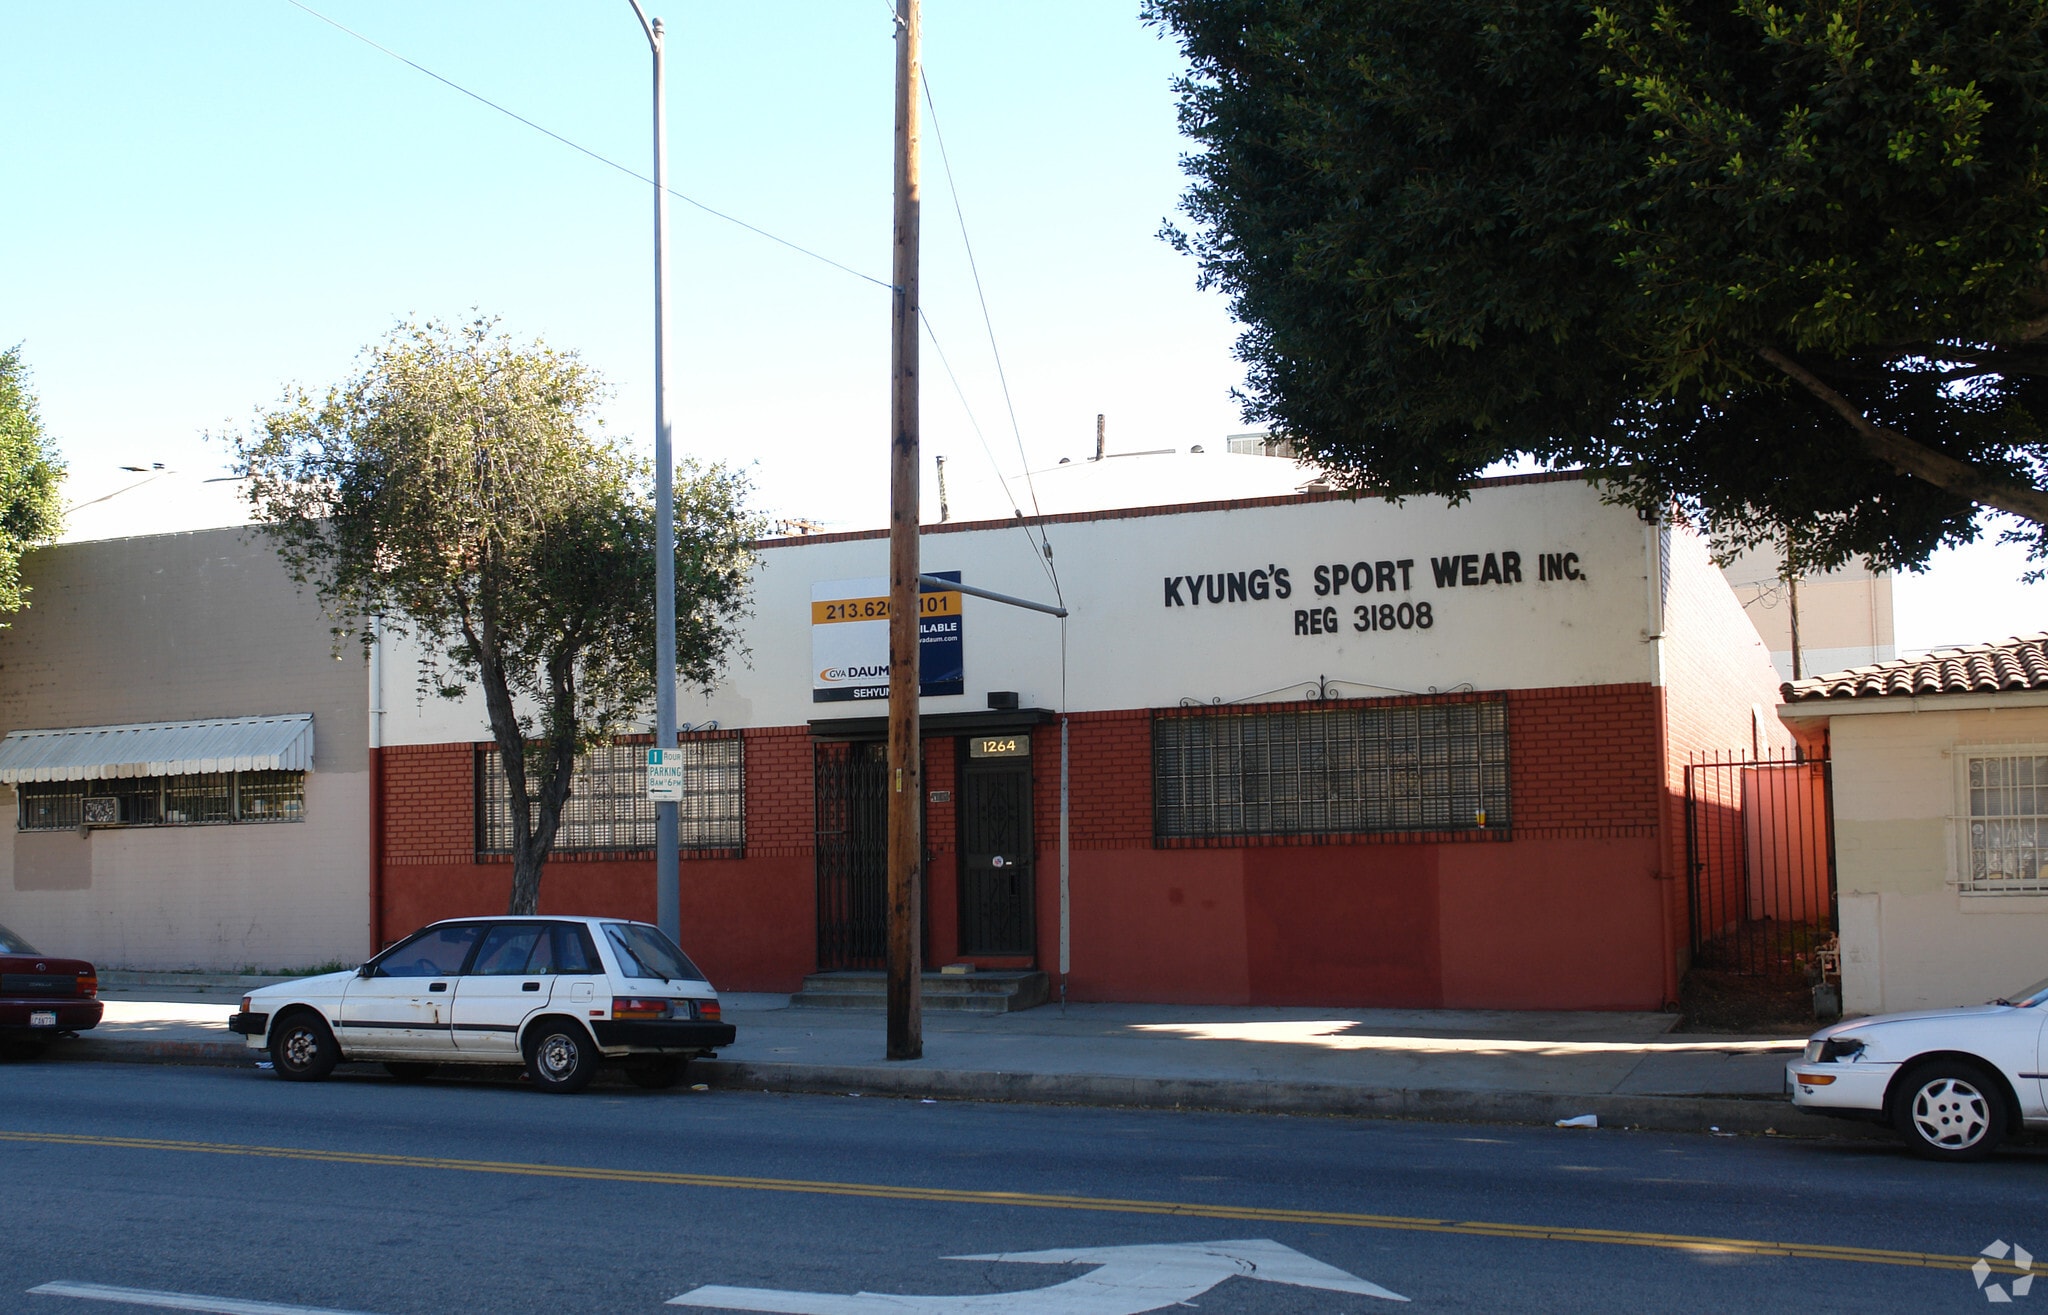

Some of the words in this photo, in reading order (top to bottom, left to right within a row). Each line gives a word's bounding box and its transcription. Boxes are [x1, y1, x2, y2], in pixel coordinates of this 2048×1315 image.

[1164, 564, 1292, 608] KYUNG'S
[1314, 559, 1414, 597] SPORT
[1431, 551, 1522, 589] WEAR
[1538, 552, 1587, 582] INC.
[1294, 606, 1338, 636] REG
[1353, 601, 1434, 633] 31808
[920, 622, 957, 634] ILABLE
[829, 670, 847, 679] GVA
[848, 665, 890, 678] DAUM
[983, 740, 1016, 753] 1264
[650, 766, 682, 777] PARKING
